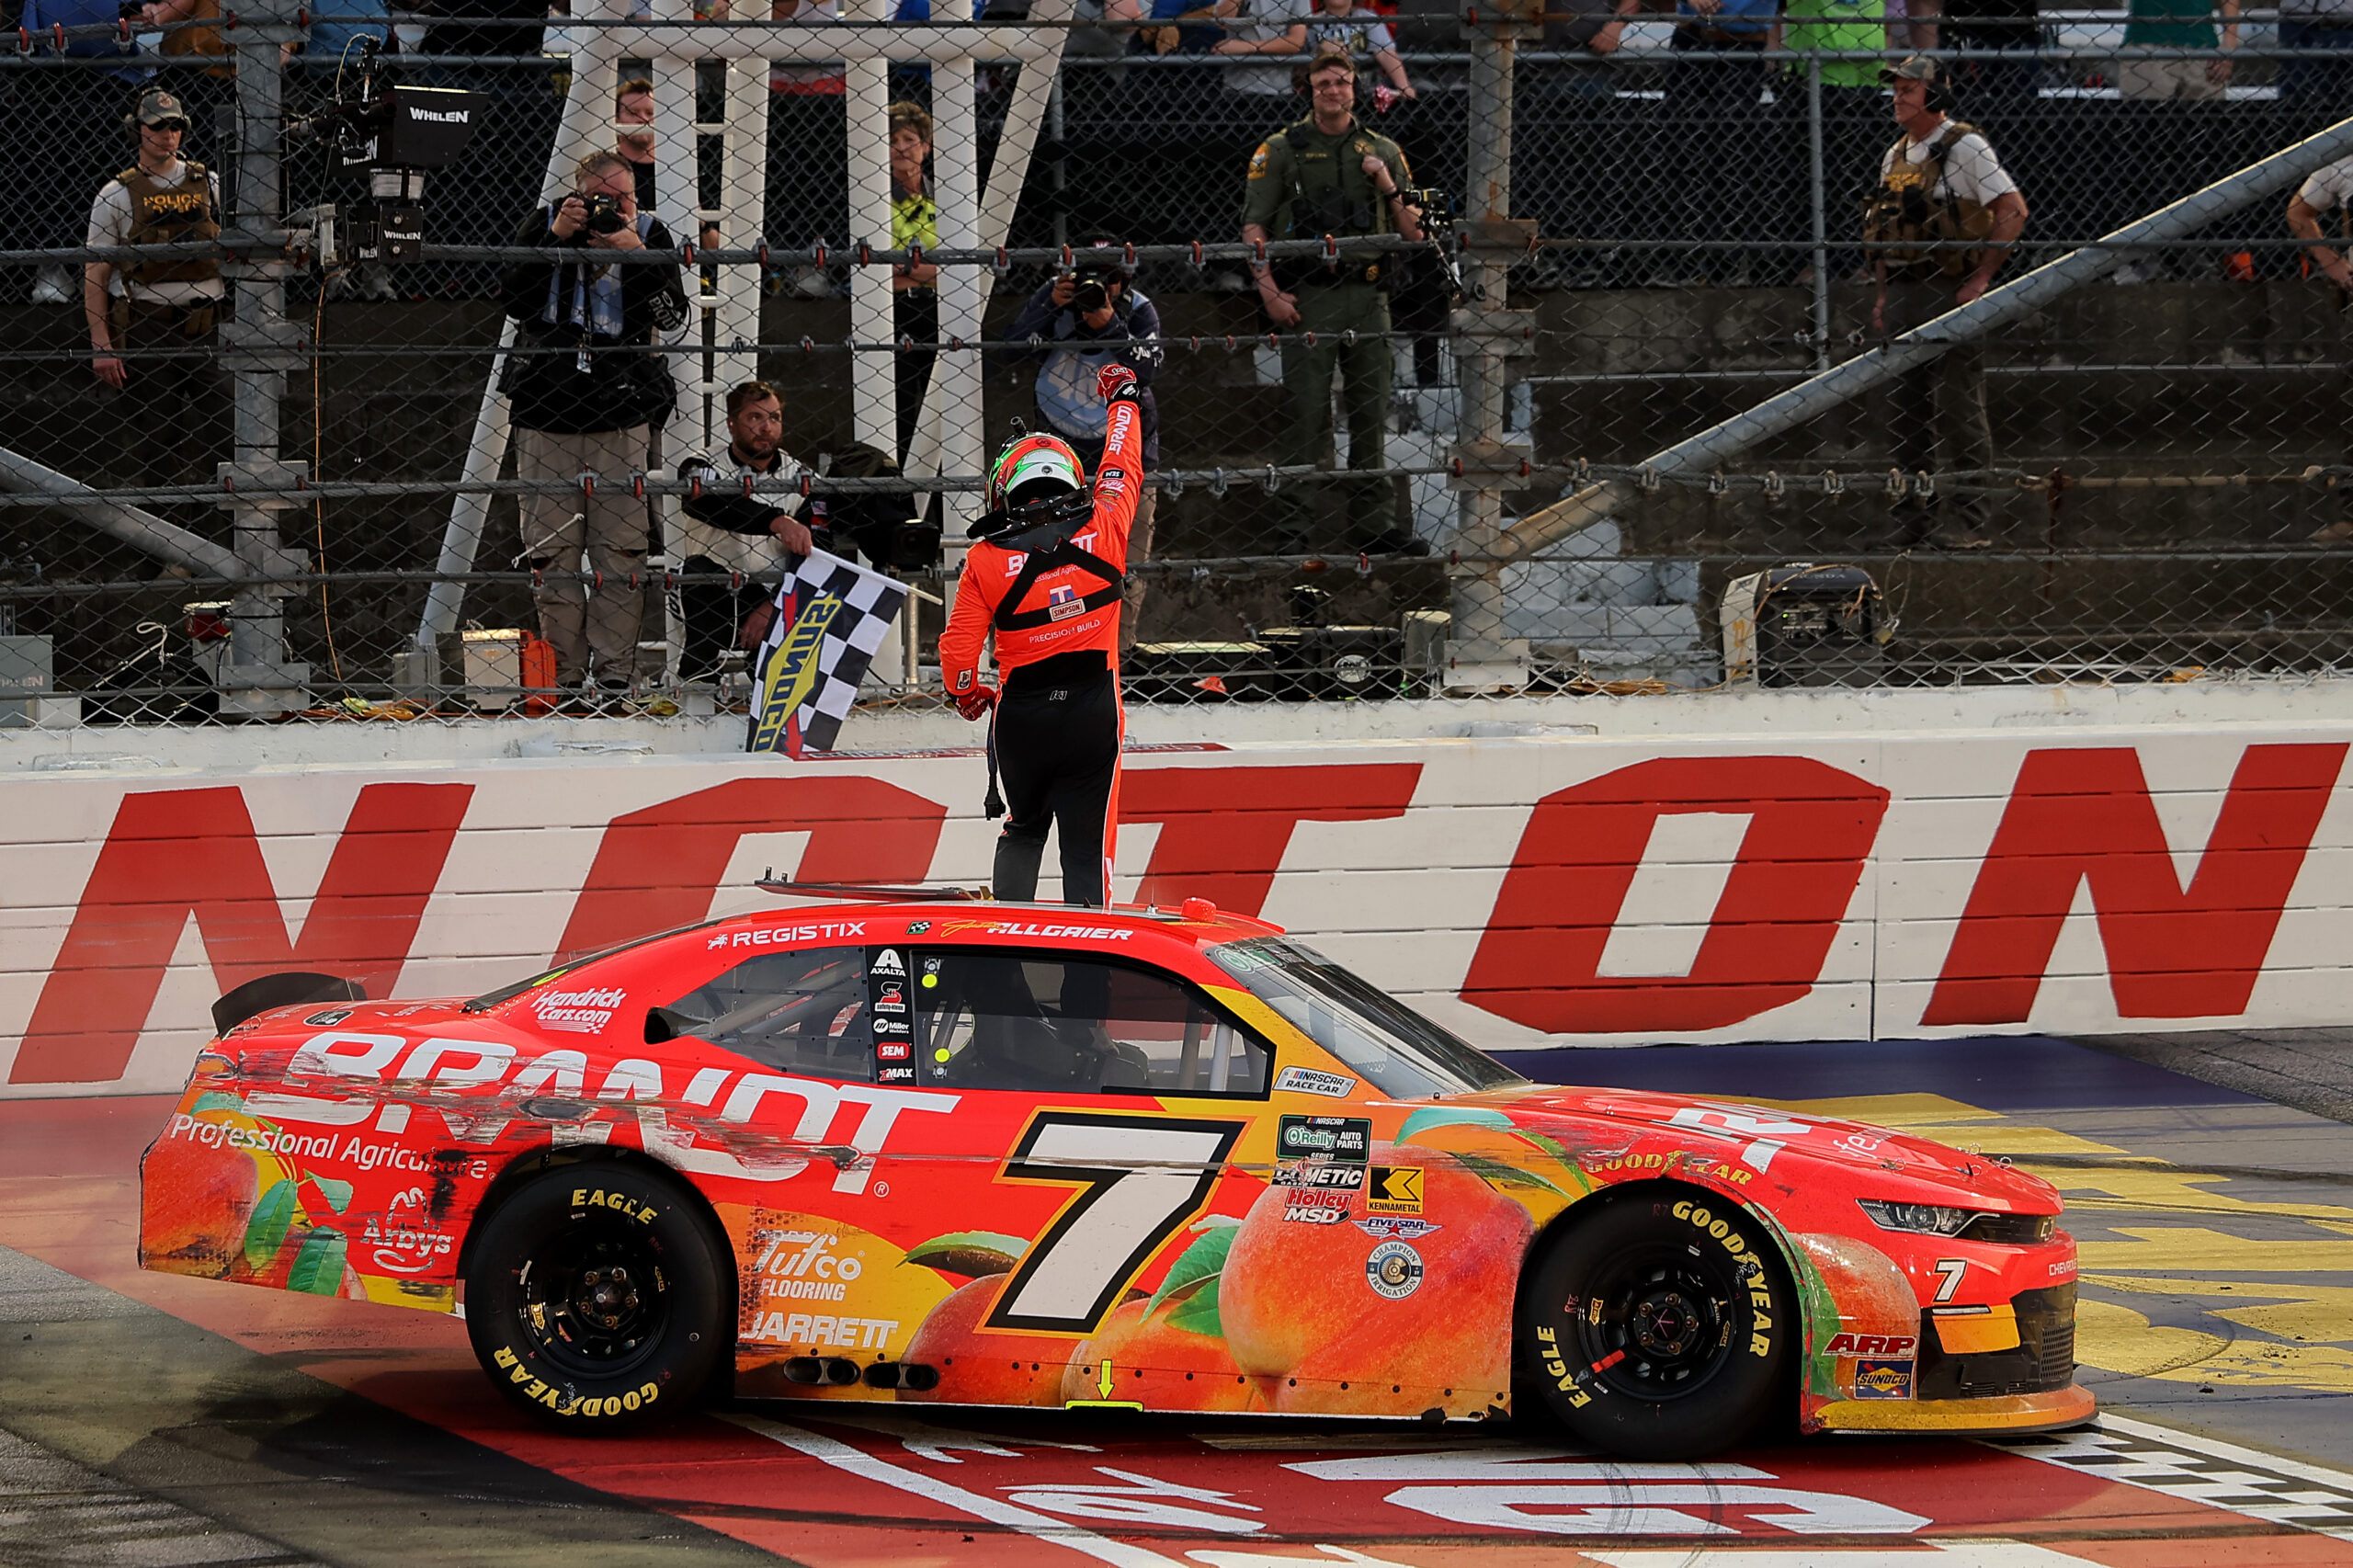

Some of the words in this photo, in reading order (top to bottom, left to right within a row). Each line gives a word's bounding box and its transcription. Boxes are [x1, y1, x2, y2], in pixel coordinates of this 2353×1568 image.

[409, 107, 469, 123] WHELEN
[384, 230, 421, 240] WHELEN
[1108, 405, 1132, 455] BRANDT
[1053, 604, 1080, 617] SIMPSON
[1077, 619, 1100, 632] BUILD
[733, 922, 867, 948] REGISTIX
[987, 923, 1134, 940] ALLGAIER
[870, 968, 906, 977] AXALTA
[530, 987, 627, 1013] Hendrick
[538, 1006, 612, 1024] Cars.com
[882, 1046, 904, 1056] SEM
[1286, 1080, 1316, 1090] RACE
[1318, 1084, 1339, 1094] CAR
[1302, 1072, 1345, 1086] NASCAR
[1315, 1118, 1346, 1126] NASCAR
[169, 1115, 338, 1160] Professional
[1287, 1127, 1336, 1149] O'Reilly
[1340, 1131, 1361, 1141] AUTO
[1336, 1140, 1363, 1149] PARTS
[1311, 1153, 1335, 1161] SERIES
[572, 1189, 657, 1224] EAGLE
[1288, 1189, 1349, 1212] Holley
[1370, 1202, 1421, 1212] KENNAMETAL
[984, 1110, 1248, 1335] 7
[1283, 1208, 1340, 1223] MSD
[1368, 1219, 1394, 1227] FIVE
[1398, 1221, 1424, 1229] STAR
[755, 1229, 861, 1281] Tufco
[1373, 1244, 1418, 1263] CHAMPION
[760, 1278, 847, 1301] FLOORING
[1370, 1276, 1418, 1297] IRRIGATION
[1933, 1258, 1968, 1303] 7
[739, 1311, 899, 1349] JARRETT
[1825, 1335, 1916, 1354] ARP
[1537, 1326, 1593, 1409] EAGLE
[1858, 1374, 1910, 1385] SUNOCO
